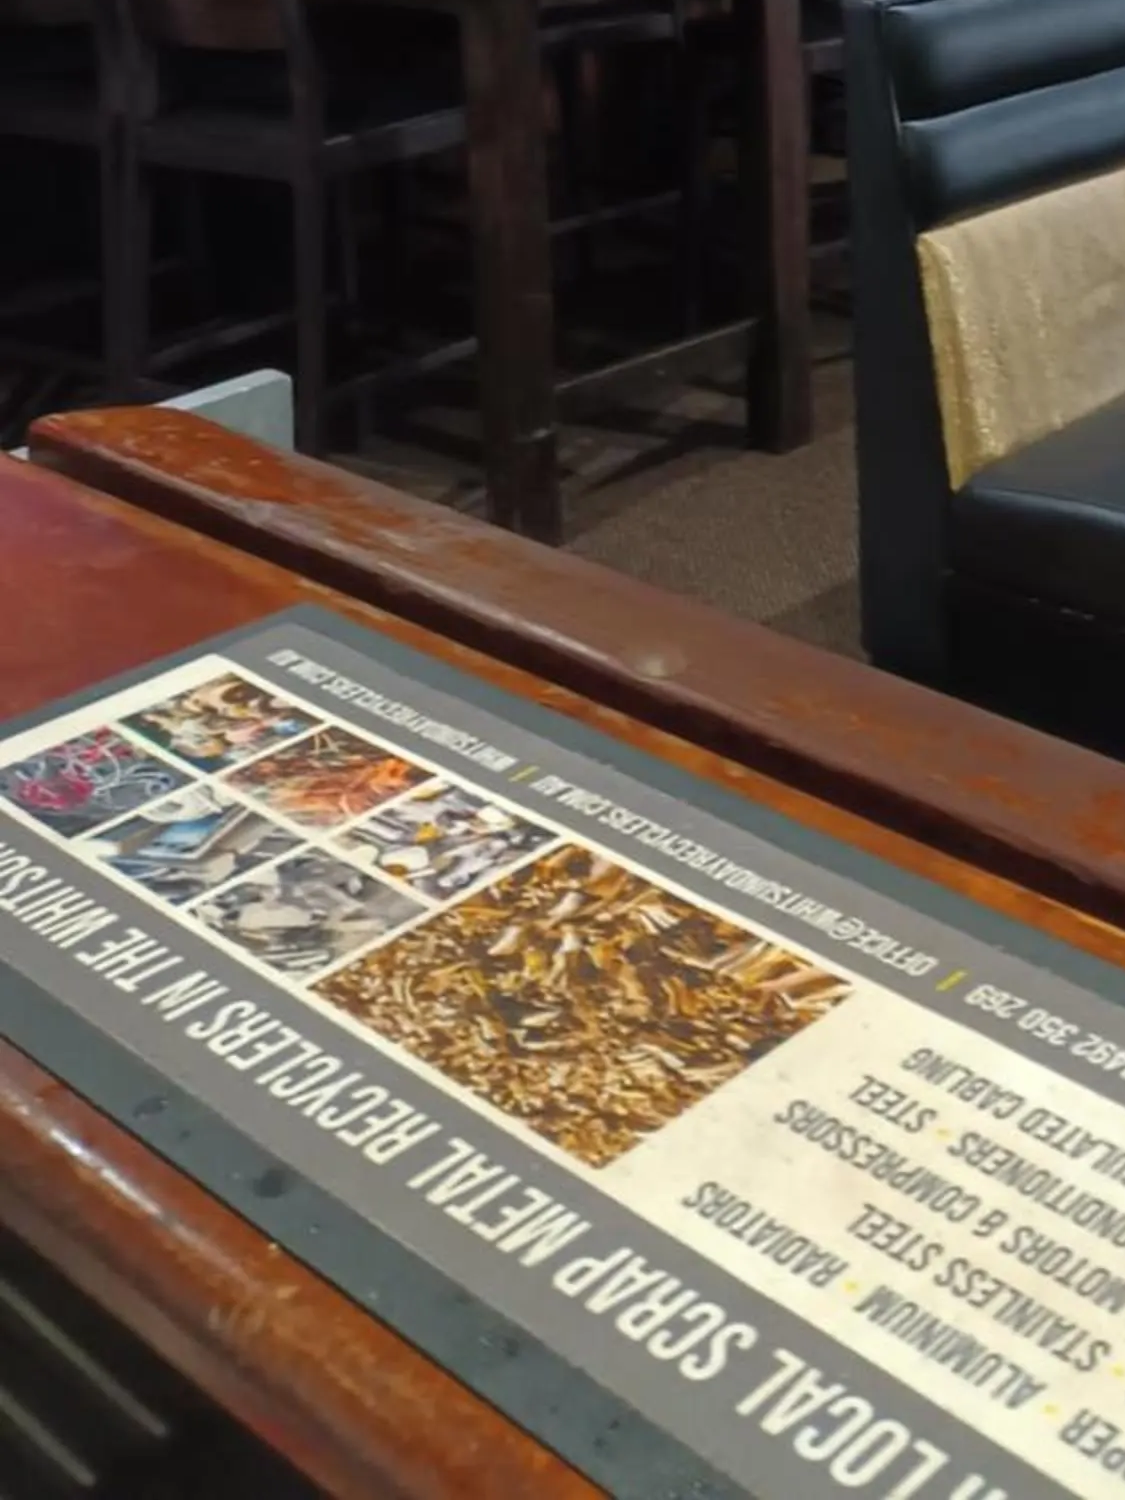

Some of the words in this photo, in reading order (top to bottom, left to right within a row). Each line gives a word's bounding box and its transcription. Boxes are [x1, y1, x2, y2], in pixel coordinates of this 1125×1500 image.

[0, 842, 119, 949] WHITSU
[75, 928, 183, 992] THE
[141, 971, 229, 1021] IN
[964, 984, 1028, 1019] 269
[1017, 1008, 1080, 1046] 350
[185, 998, 441, 1164] RECYCLERS
[848, 1074, 938, 1134] STEEL
[900, 1047, 1026, 1120] CABLING
[407, 1137, 592, 1267] METAL
[773, 1099, 981, 1223] COMPRESSORS
[681, 1181, 849, 1288] RADIATORS
[847, 1203, 945, 1272] STEEL
[971, 1208, 1009, 1238] &
[553, 1247, 757, 1380] SCRAP
[853, 1285, 1047, 1409] ALUMINIUM
[933, 1257, 1112, 1373] STAINLESS
[736, 1349, 948, 1500] LOCAL
